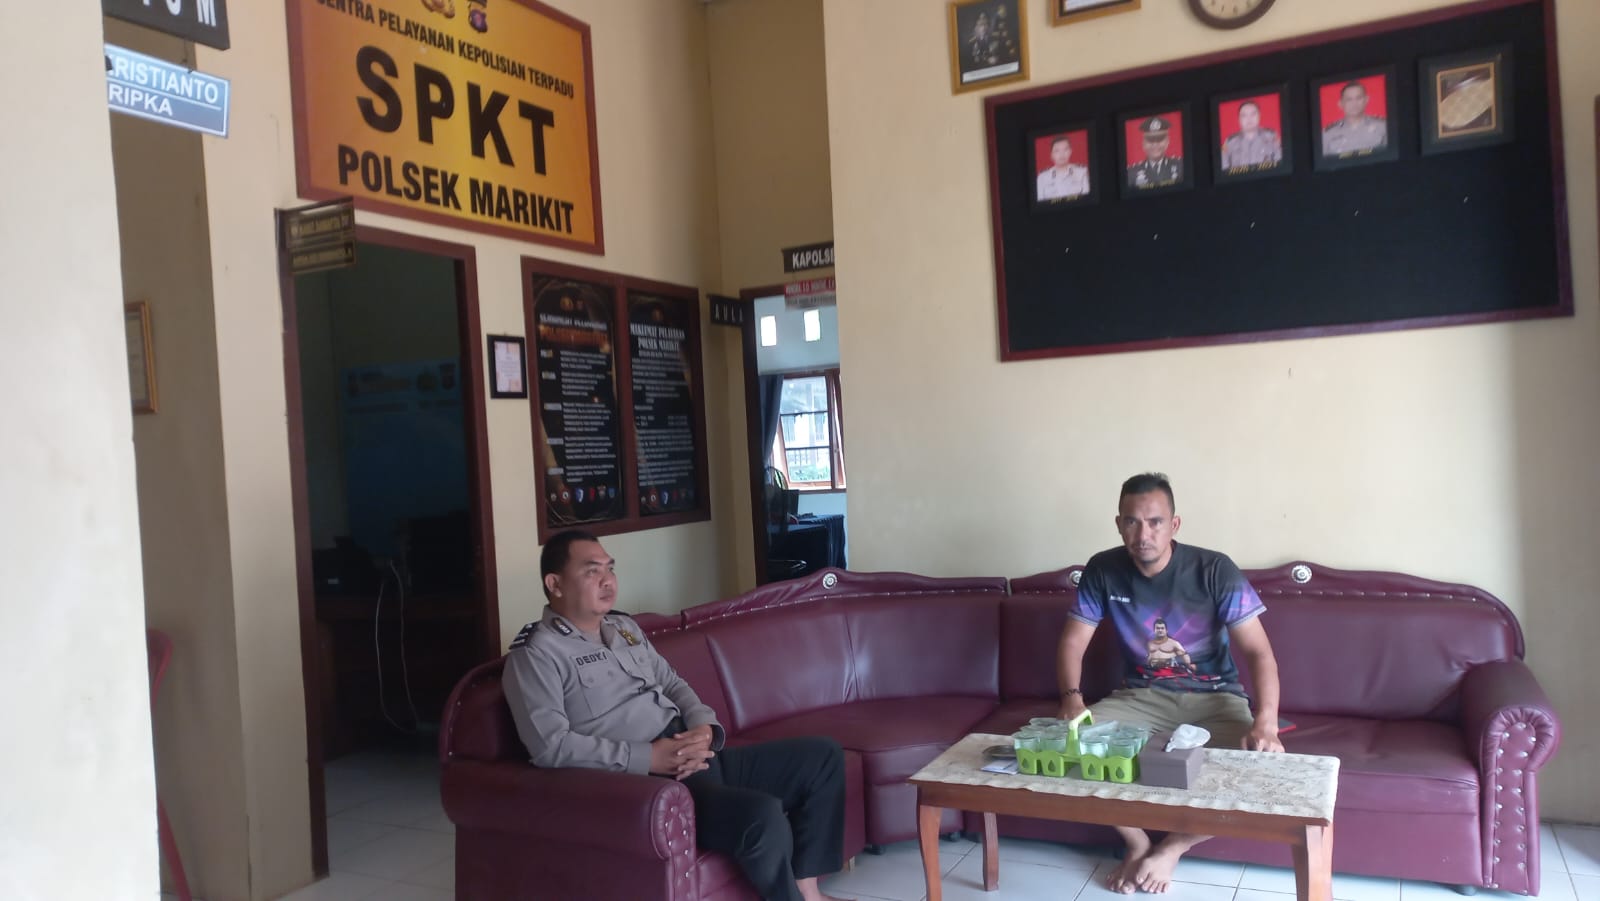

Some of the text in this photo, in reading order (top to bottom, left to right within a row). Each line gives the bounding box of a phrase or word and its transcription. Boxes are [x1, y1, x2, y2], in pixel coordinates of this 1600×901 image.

[316, 0, 574, 99] NTRA PELAYANAN KEPOLISIAN TERPADU
[355, 45, 554, 176] SPKT
[338, 144, 574, 234] POLSEK MARIKIT
